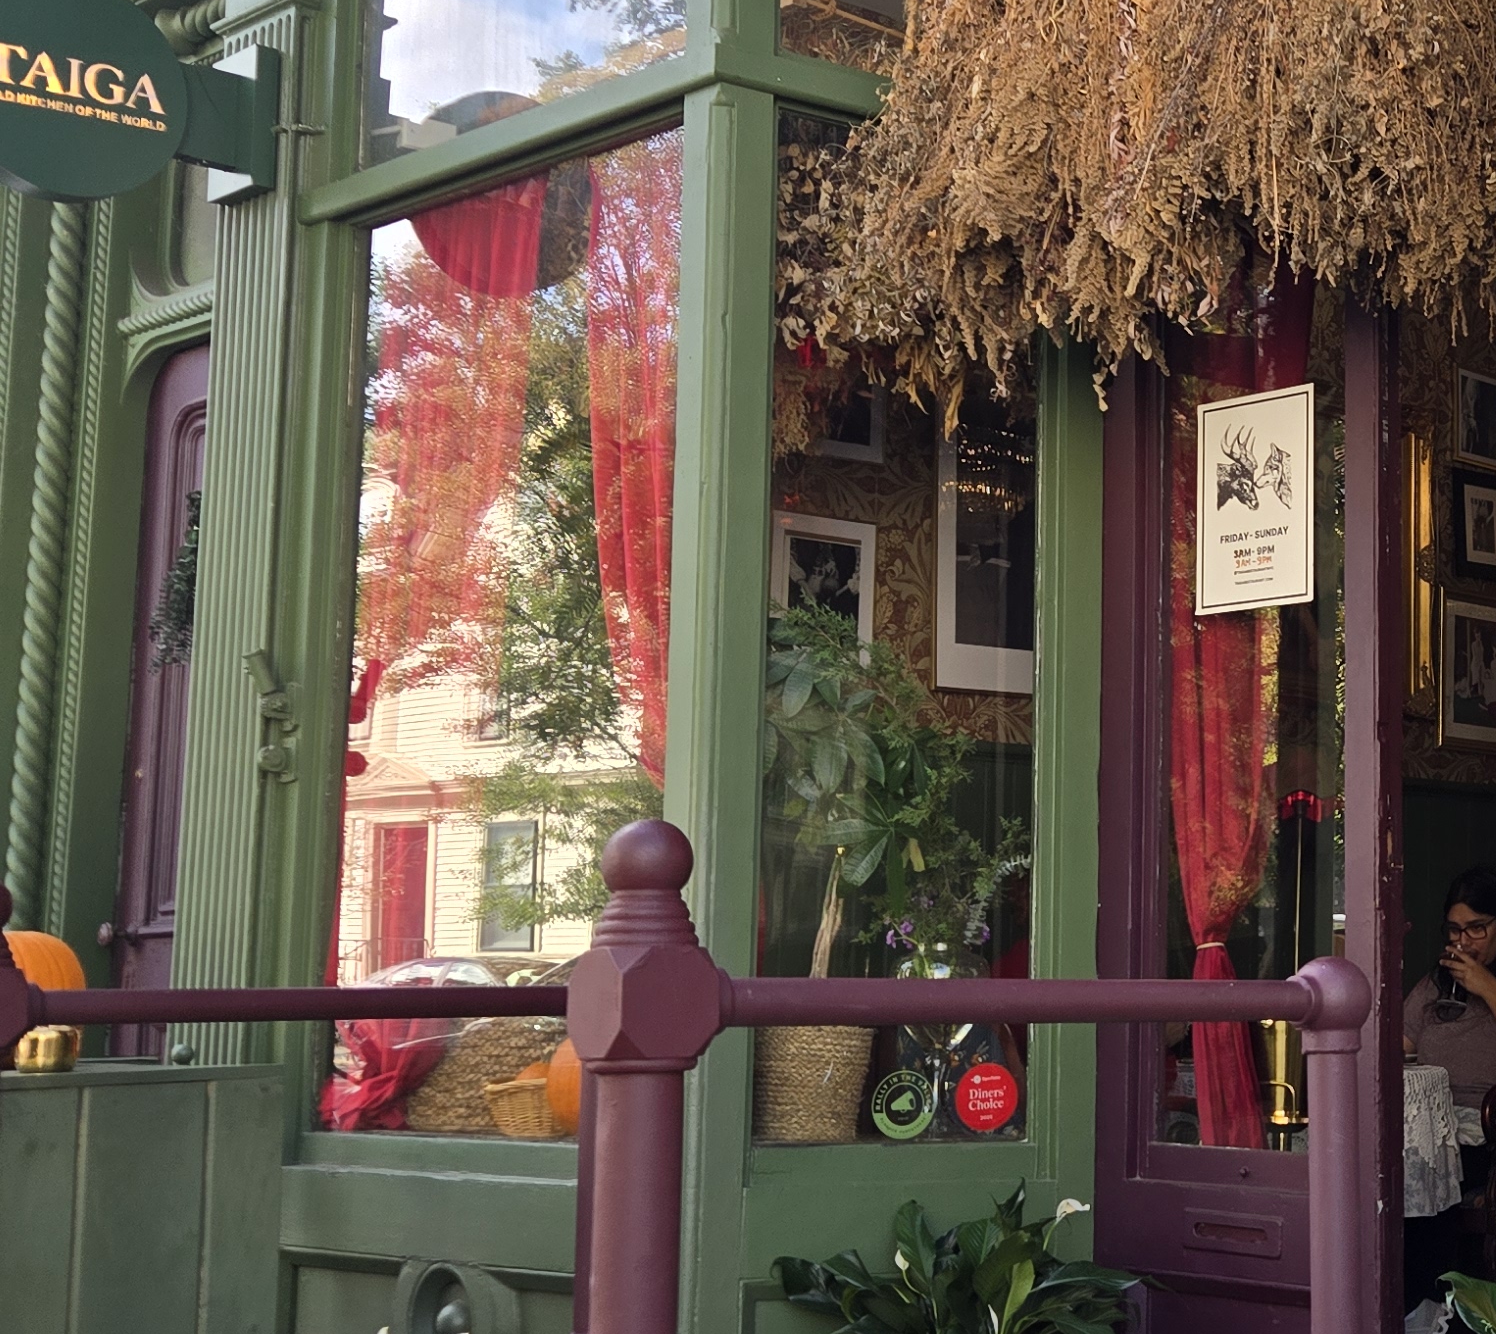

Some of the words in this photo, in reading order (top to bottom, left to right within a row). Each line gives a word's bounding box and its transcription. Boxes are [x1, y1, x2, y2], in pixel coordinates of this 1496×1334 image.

[0, 42, 167, 115] TAIGA
[17, 92, 73, 113] KITCHEN
[75, 104, 94, 117] OF
[94, 108, 119, 123] THE
[120, 113, 168, 132] WORLD
[1254, 526, 1289, 539] SUNDAY
[968, 1098, 1005, 1111] Choice
